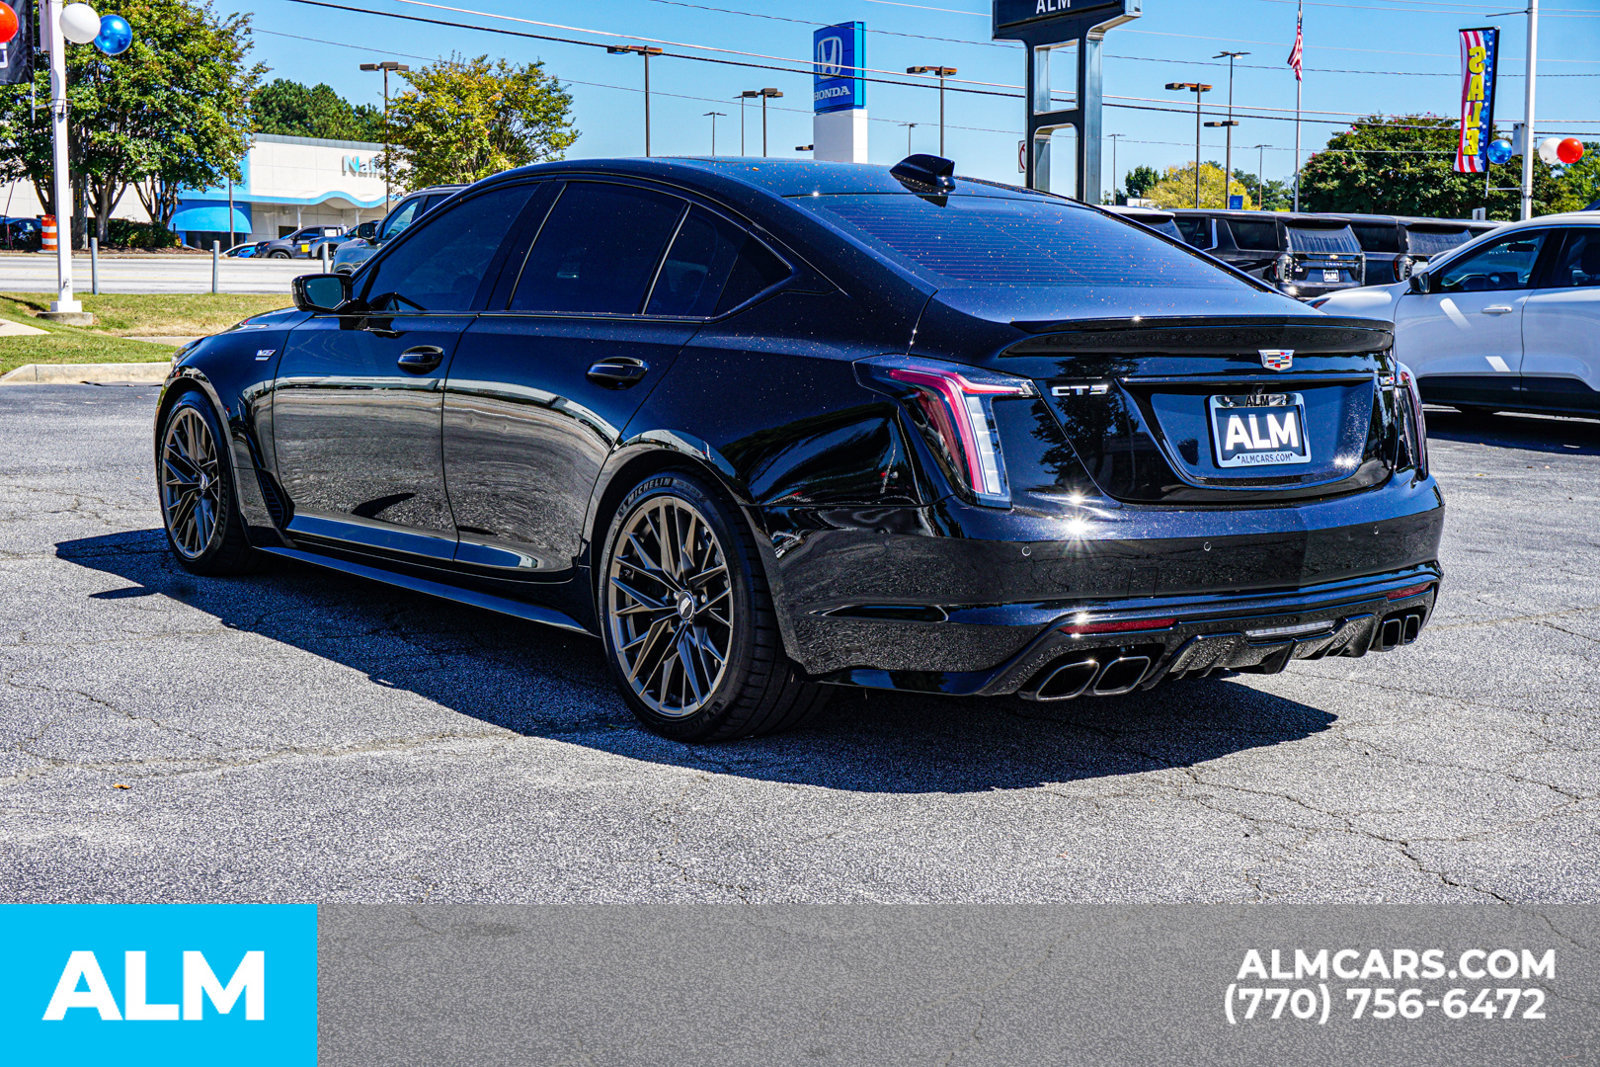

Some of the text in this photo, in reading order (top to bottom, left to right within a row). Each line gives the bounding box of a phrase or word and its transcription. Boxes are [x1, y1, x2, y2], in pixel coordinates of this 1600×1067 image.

[1035, 0, 1071, 15] ALM
[814, 85, 851, 101] HONDA
[1245, 394, 1270, 407] ALM
[1225, 411, 1300, 451] ALM
[1241, 453, 1291, 464] ALMCARS.COM
[627, 478, 671, 505] MICHELIN
